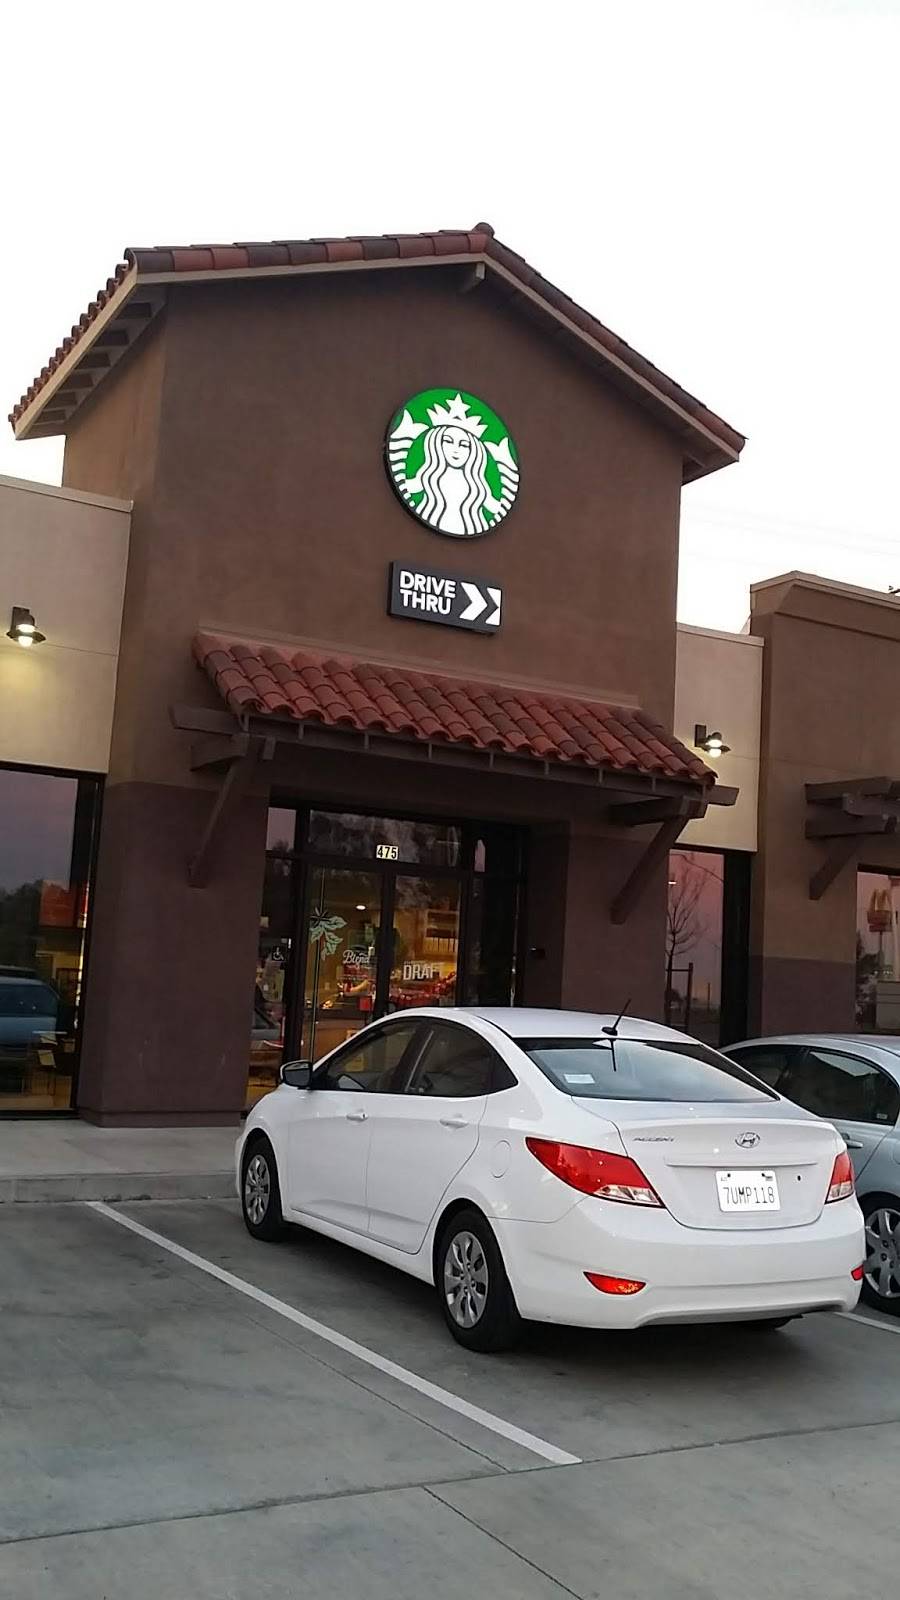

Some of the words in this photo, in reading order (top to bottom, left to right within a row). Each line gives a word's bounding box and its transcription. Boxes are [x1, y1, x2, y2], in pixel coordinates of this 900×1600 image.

[400, 570, 456, 598] DRIVE
[400, 588, 452, 615] THRU
[377, 845, 397, 859] 475
[722, 1186, 775, 1205] 7UMP118
